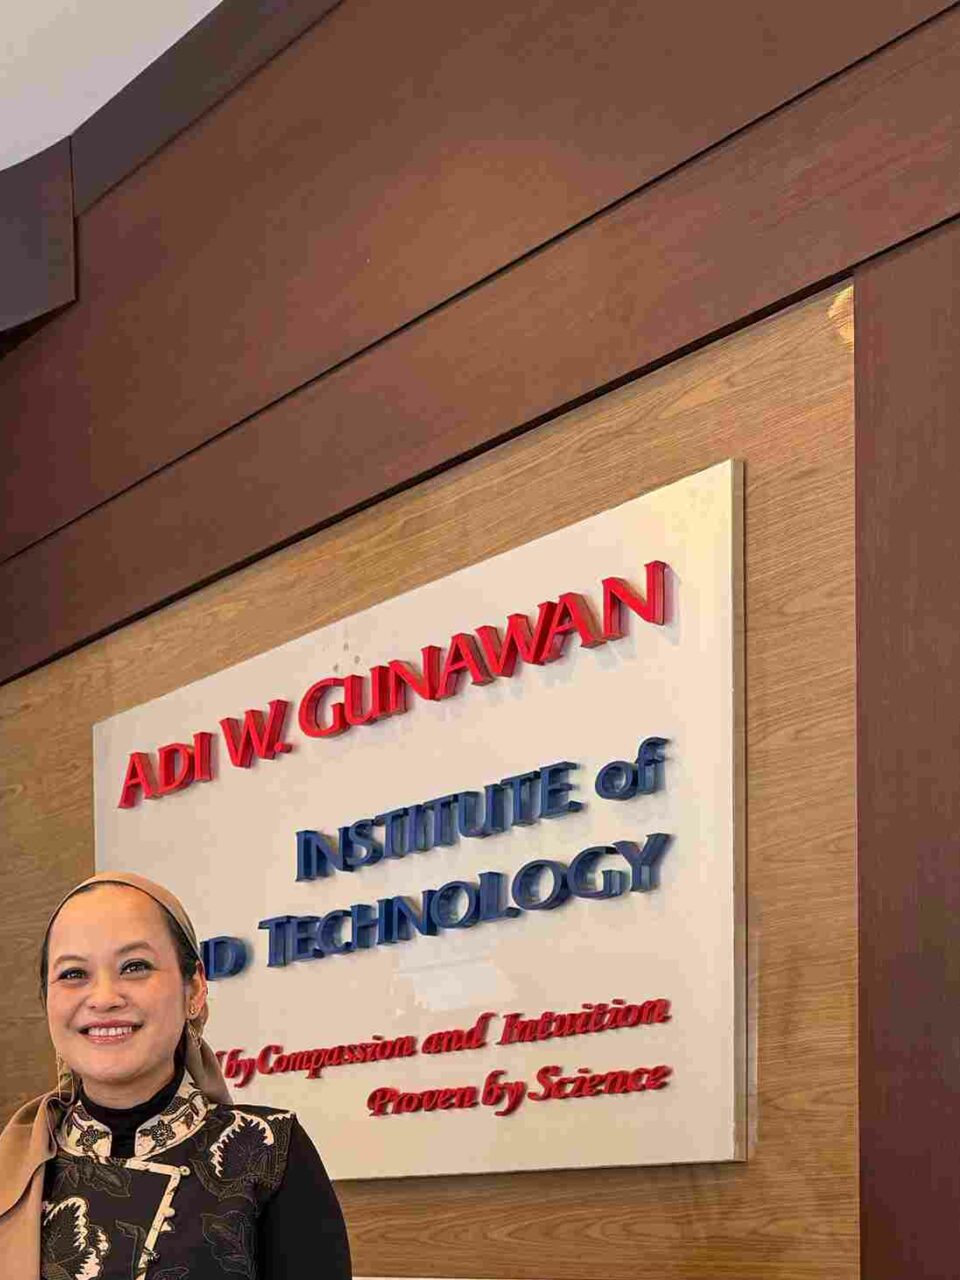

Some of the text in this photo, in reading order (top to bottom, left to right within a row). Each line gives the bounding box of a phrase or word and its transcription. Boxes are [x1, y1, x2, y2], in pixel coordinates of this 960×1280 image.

[118, 560, 671, 809] ADI W. GUNAWAN
[295, 736, 670, 882] INSTITUTE of
[257, 833, 674, 968] TECHNOLOGY
[223, 998, 672, 1088] by Compassion and Intuition
[367, 1064, 674, 1117] Proven by Science
